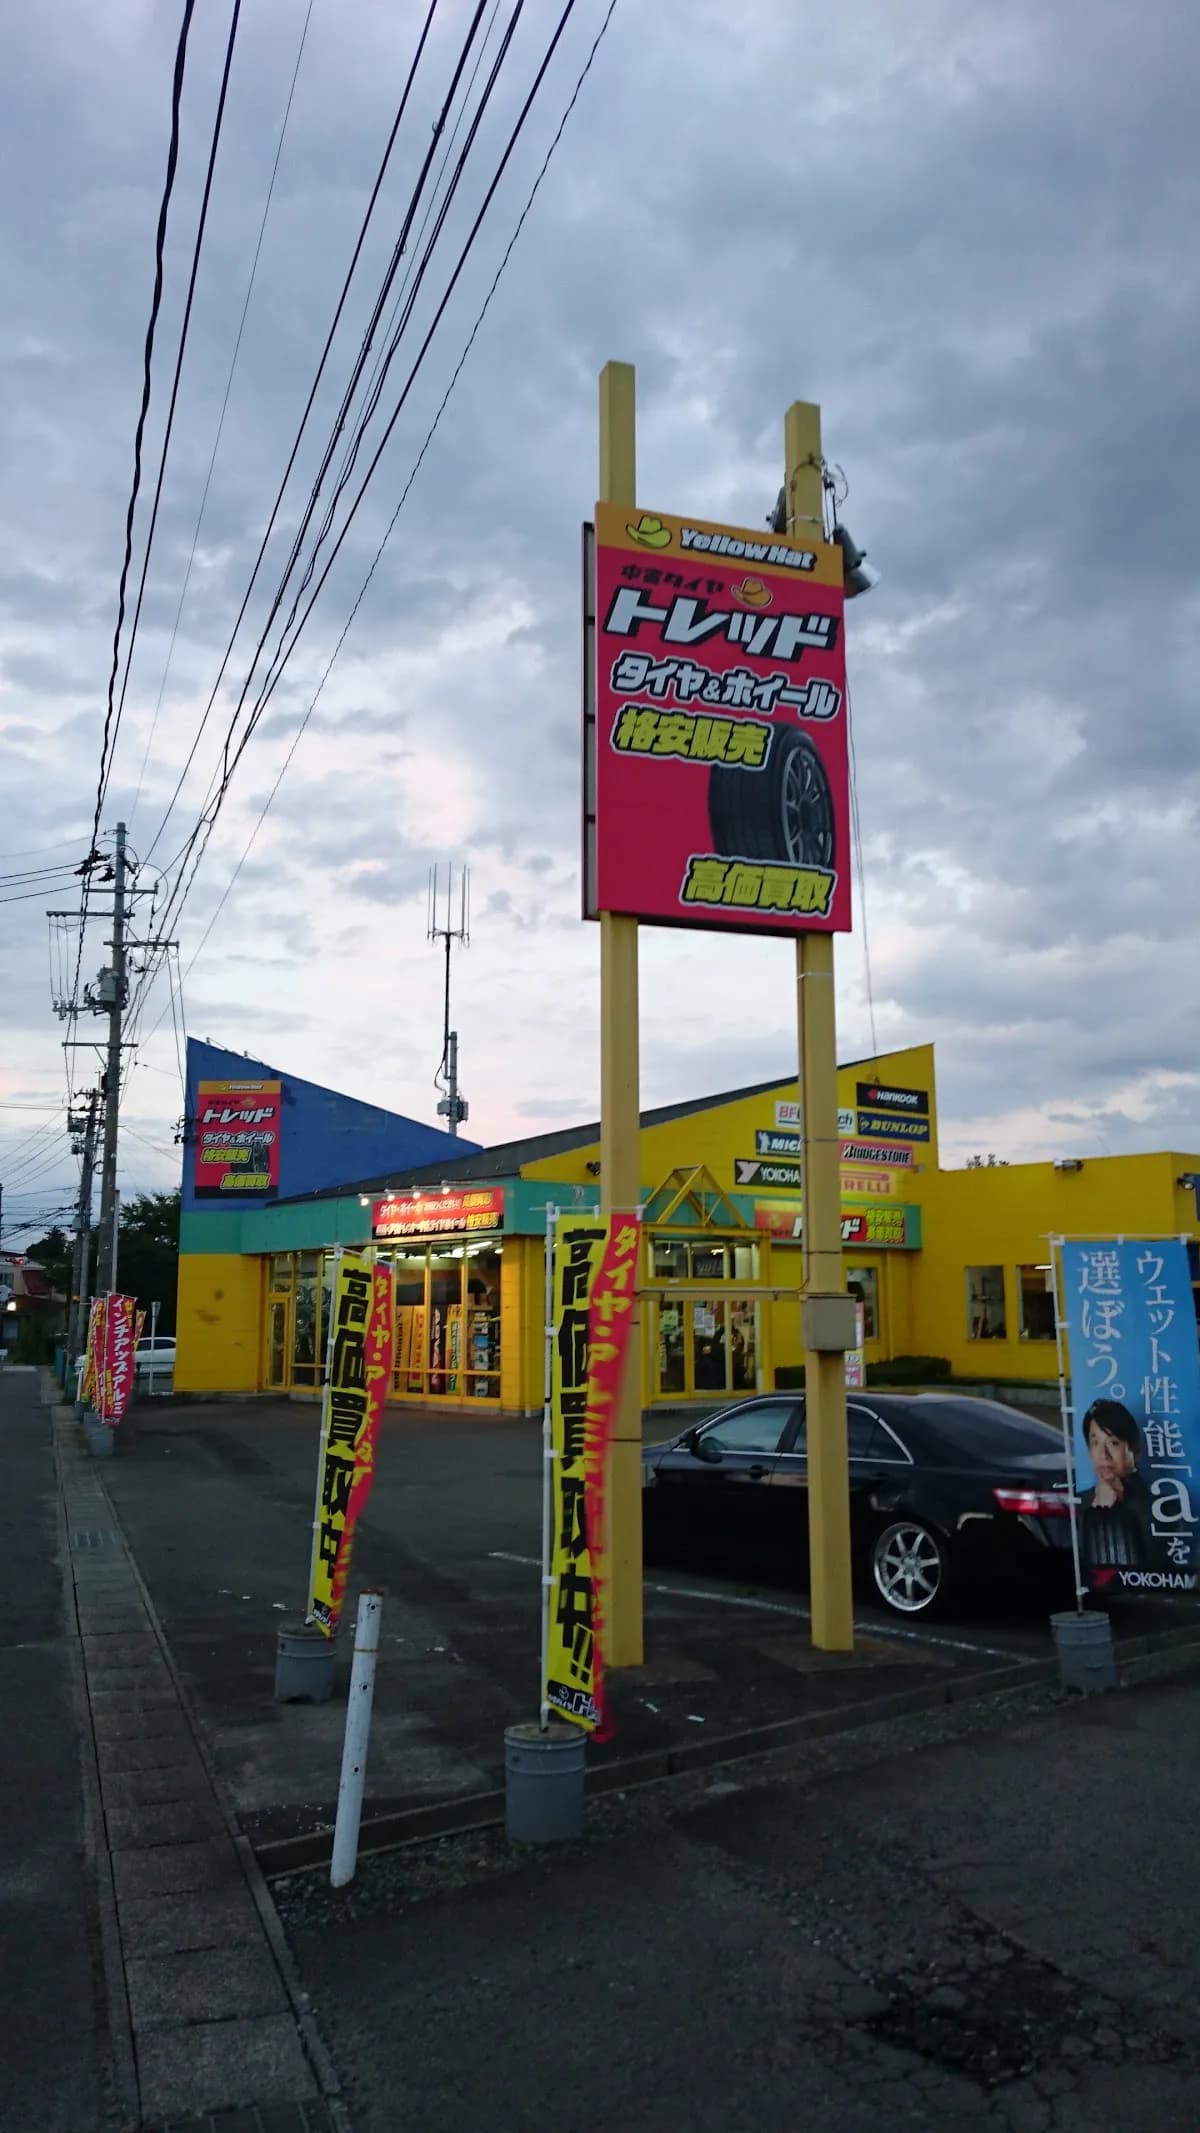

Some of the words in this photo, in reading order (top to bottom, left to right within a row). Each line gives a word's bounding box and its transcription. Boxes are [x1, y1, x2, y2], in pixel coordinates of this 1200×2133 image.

[605, 586, 838, 662] トレッド
[611, 653, 840, 718] タイヤ&ホイール
[613, 706, 772, 767] 格安販売
[682, 857, 834, 914] 高価買取
[203, 1107, 275, 1124] トレッド
[870, 1119, 928, 1135] DUNLOP
[843, 1143, 911, 1164] BRIDGESTONE
[843, 1179, 890, 1193] RELLI
[1078, 1250, 1127, 1401] 選ぼう。
